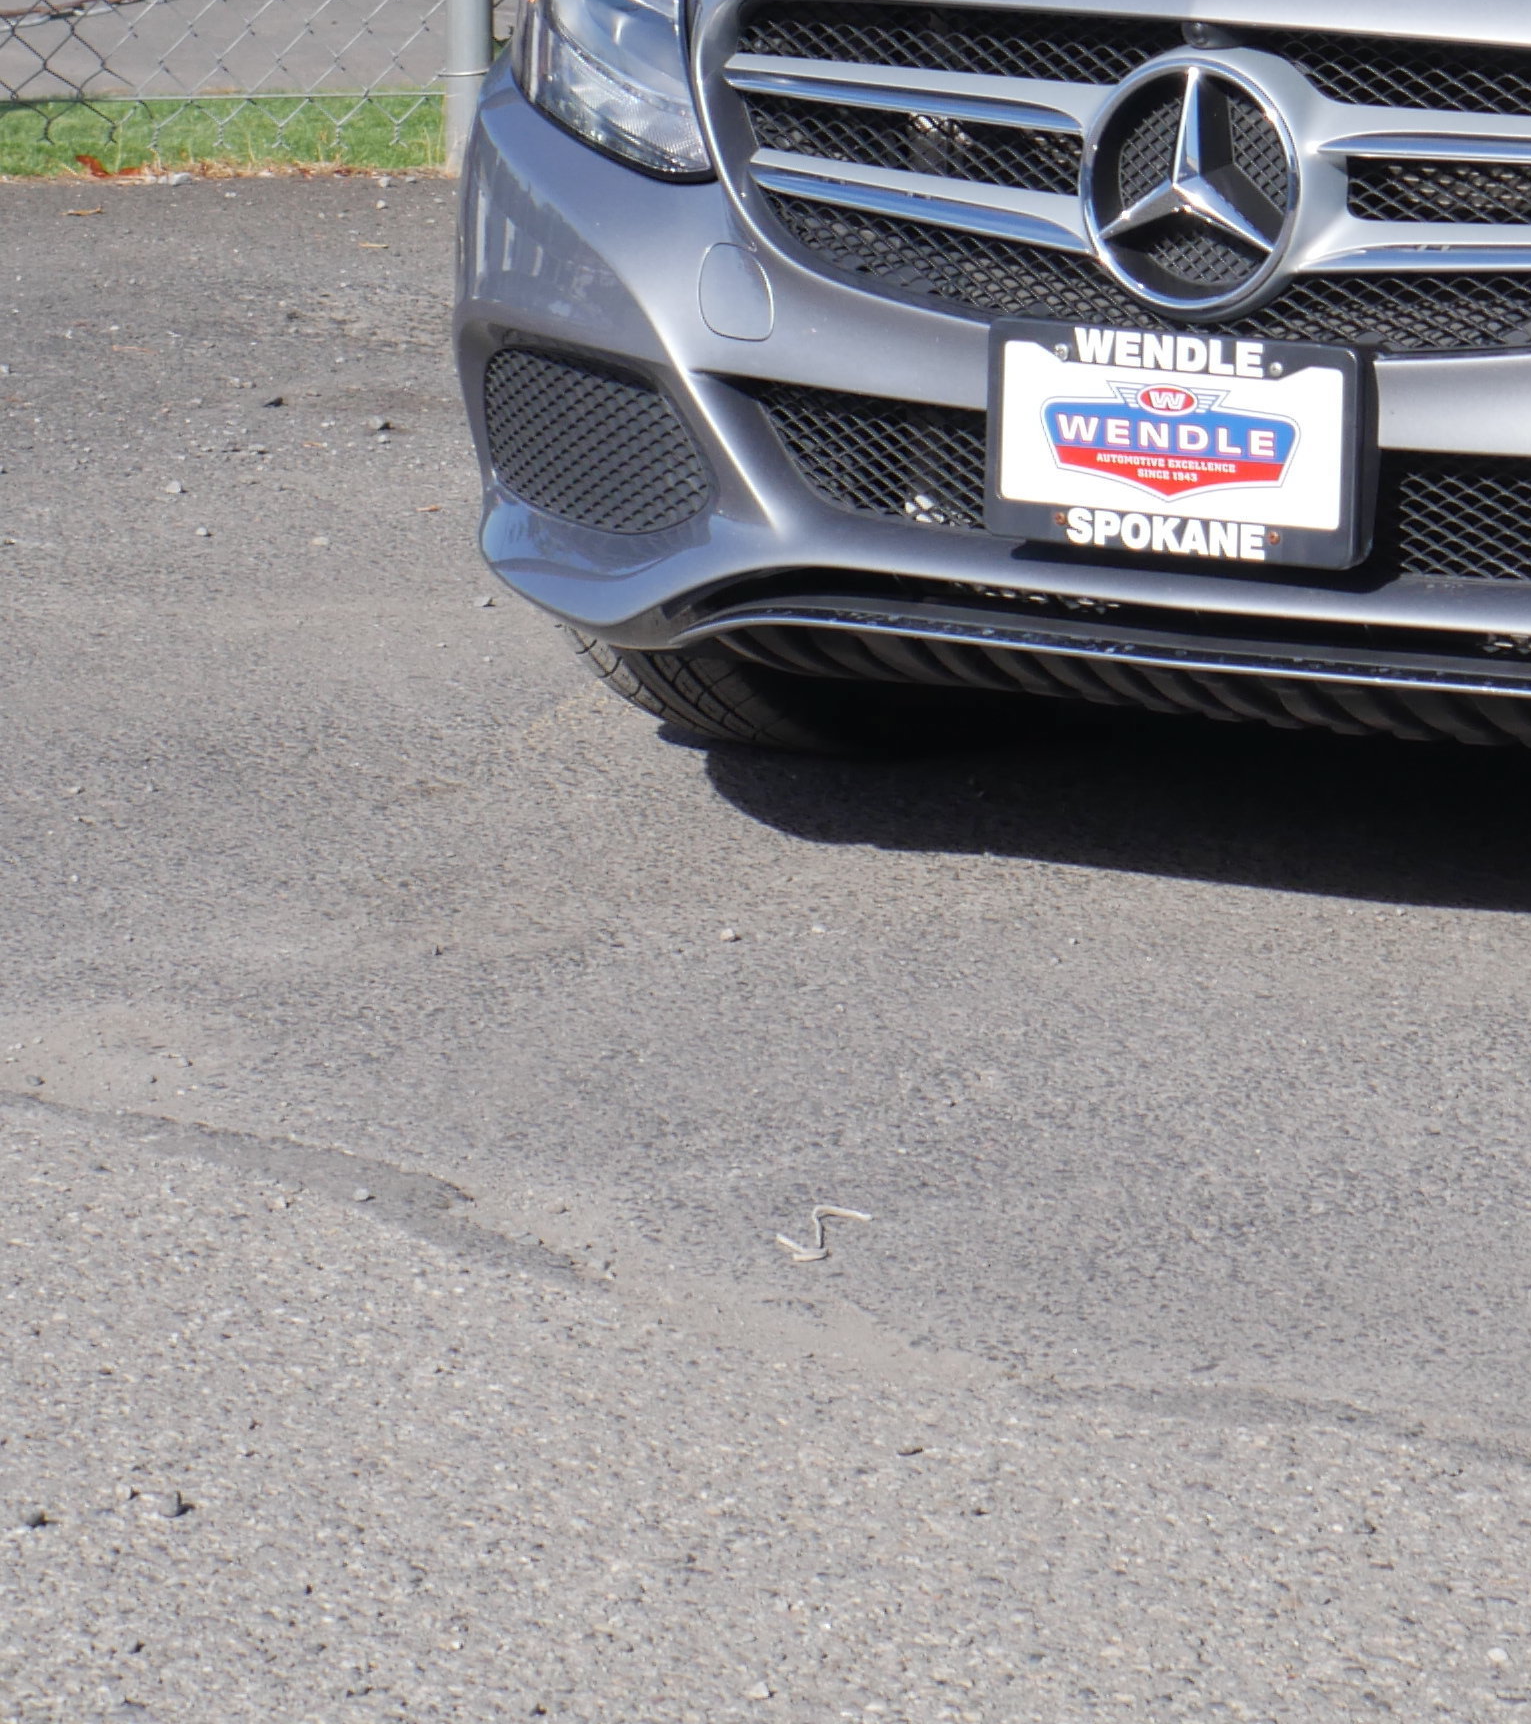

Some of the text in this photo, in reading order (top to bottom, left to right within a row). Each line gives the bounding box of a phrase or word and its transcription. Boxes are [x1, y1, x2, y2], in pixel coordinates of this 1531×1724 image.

[1074, 326, 1264, 378] WENDLE
[1057, 413, 1276, 458] WENDLE
[1096, 452, 1237, 473] AUTOMOTIVE EXCELLENCE
[1137, 468, 1199, 482] SINCE 1943
[1066, 507, 1266, 561] SPOKANE
